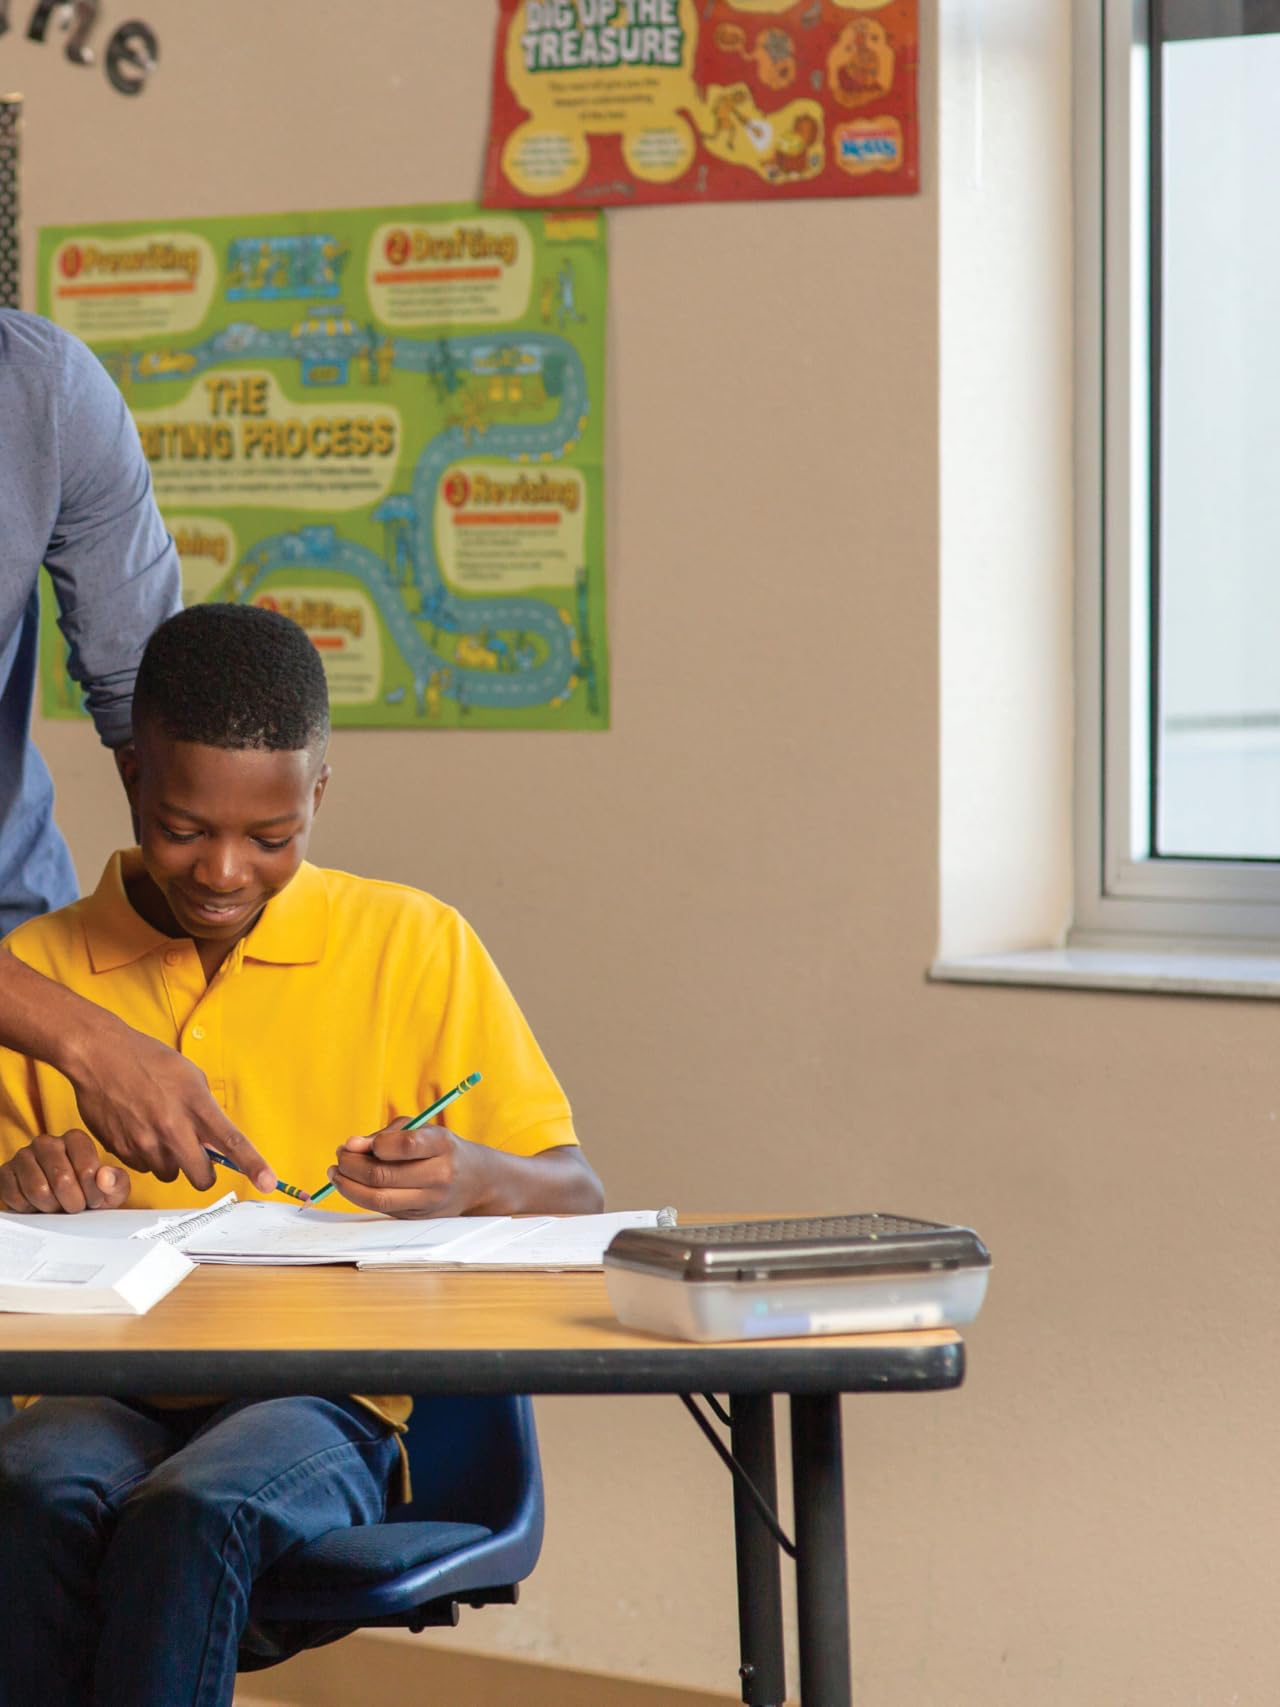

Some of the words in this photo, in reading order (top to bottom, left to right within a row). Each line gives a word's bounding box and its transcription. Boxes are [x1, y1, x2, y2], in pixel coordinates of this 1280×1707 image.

[526, 0, 574, 32] DIG
[579, 0, 617, 28] UP
[624, 0, 677, 25] THE
[522, 27, 682, 69] TREASURE
[413, 226, 519, 266] Drafting
[204, 376, 269, 417] THE
[138, 421, 234, 462] ITING
[241, 415, 396, 460] PROCESS
[471, 471, 580, 513] Revising
